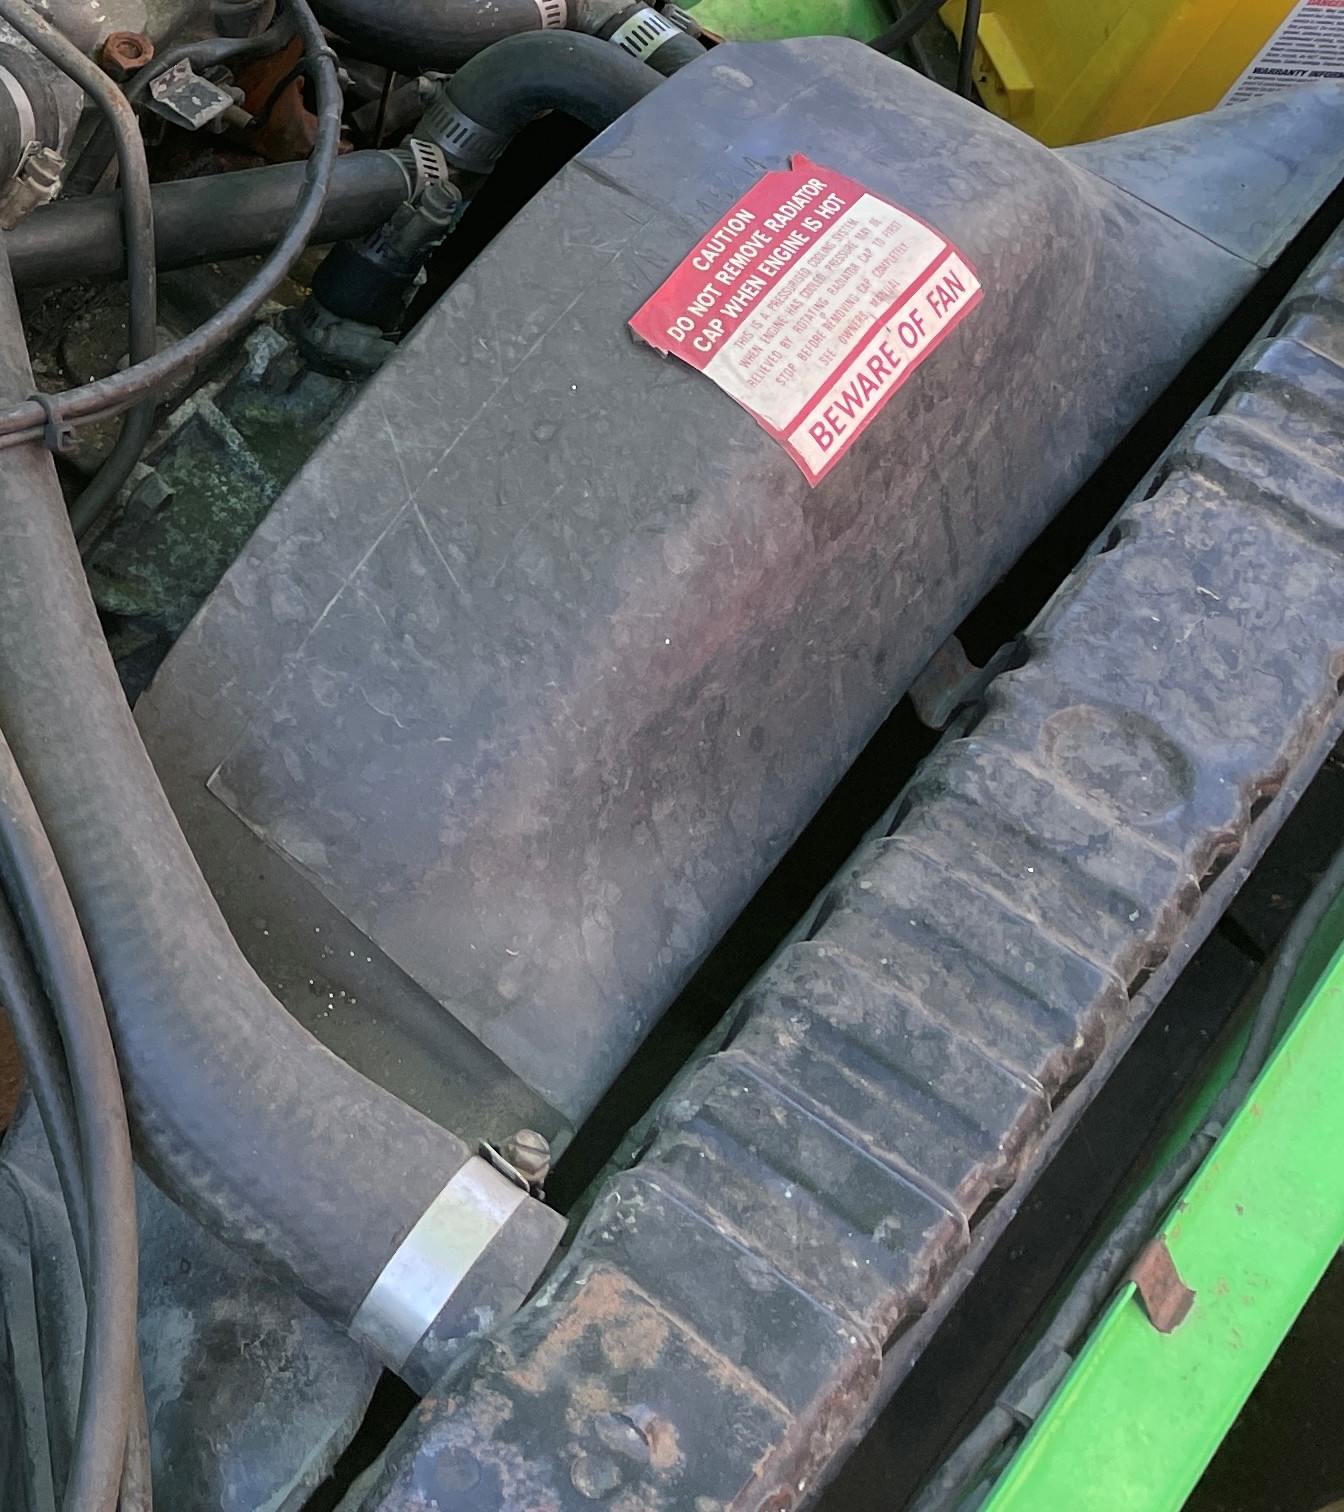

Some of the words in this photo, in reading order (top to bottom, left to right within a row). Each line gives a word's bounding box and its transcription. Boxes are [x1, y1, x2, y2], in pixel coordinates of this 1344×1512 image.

[1252, 67, 1309, 76] WARRANTY
[667, 317, 694, 342] DO
[688, 283, 721, 317] NOT
[715, 230, 772, 285] REMOVE
[764, 178, 827, 232] RADIATOR
[693, 209, 755, 270] CAUTION
[693, 319, 724, 351] CAP
[720, 275, 766, 318] WHEN
[758, 230, 810, 276] ENGINE
[801, 217, 822, 232] IS
[815, 193, 845, 219] HOT
[733, 330, 753, 348] THIS
[750, 319, 764, 330] IS
[760, 311, 770, 321] A
[766, 267, 811, 310] PRESSURISED
[807, 240, 835, 268] COOLING
[740, 344, 763, 369] WHEN
[762, 317, 788, 344] ENGINE
[786, 299, 804, 316] HAS
[824, 240, 857, 272] PRESSURE
[747, 350, 783, 388] RELIEVED
[780, 336, 792, 350] BY
[792, 297, 830, 334] ROTATING
[827, 262, 860, 295] RADIATOR
[859, 246, 874, 264] CAP
[872, 236, 885, 248] TO
[882, 219, 901, 238] FIRST
[776, 363, 798, 386] STOP
[797, 330, 825, 362] BEFORE
[822, 295, 858, 332] REMOVING
[856, 278, 872, 294] CAP
[809, 341, 900, 451] BEWARE
[898, 309, 925, 348] OF
[927, 271, 965, 318] FAN
[820, 348, 838, 366] SEE
[838, 311, 868, 345] OWNERS
[869, 278, 900, 308] MANUAL
